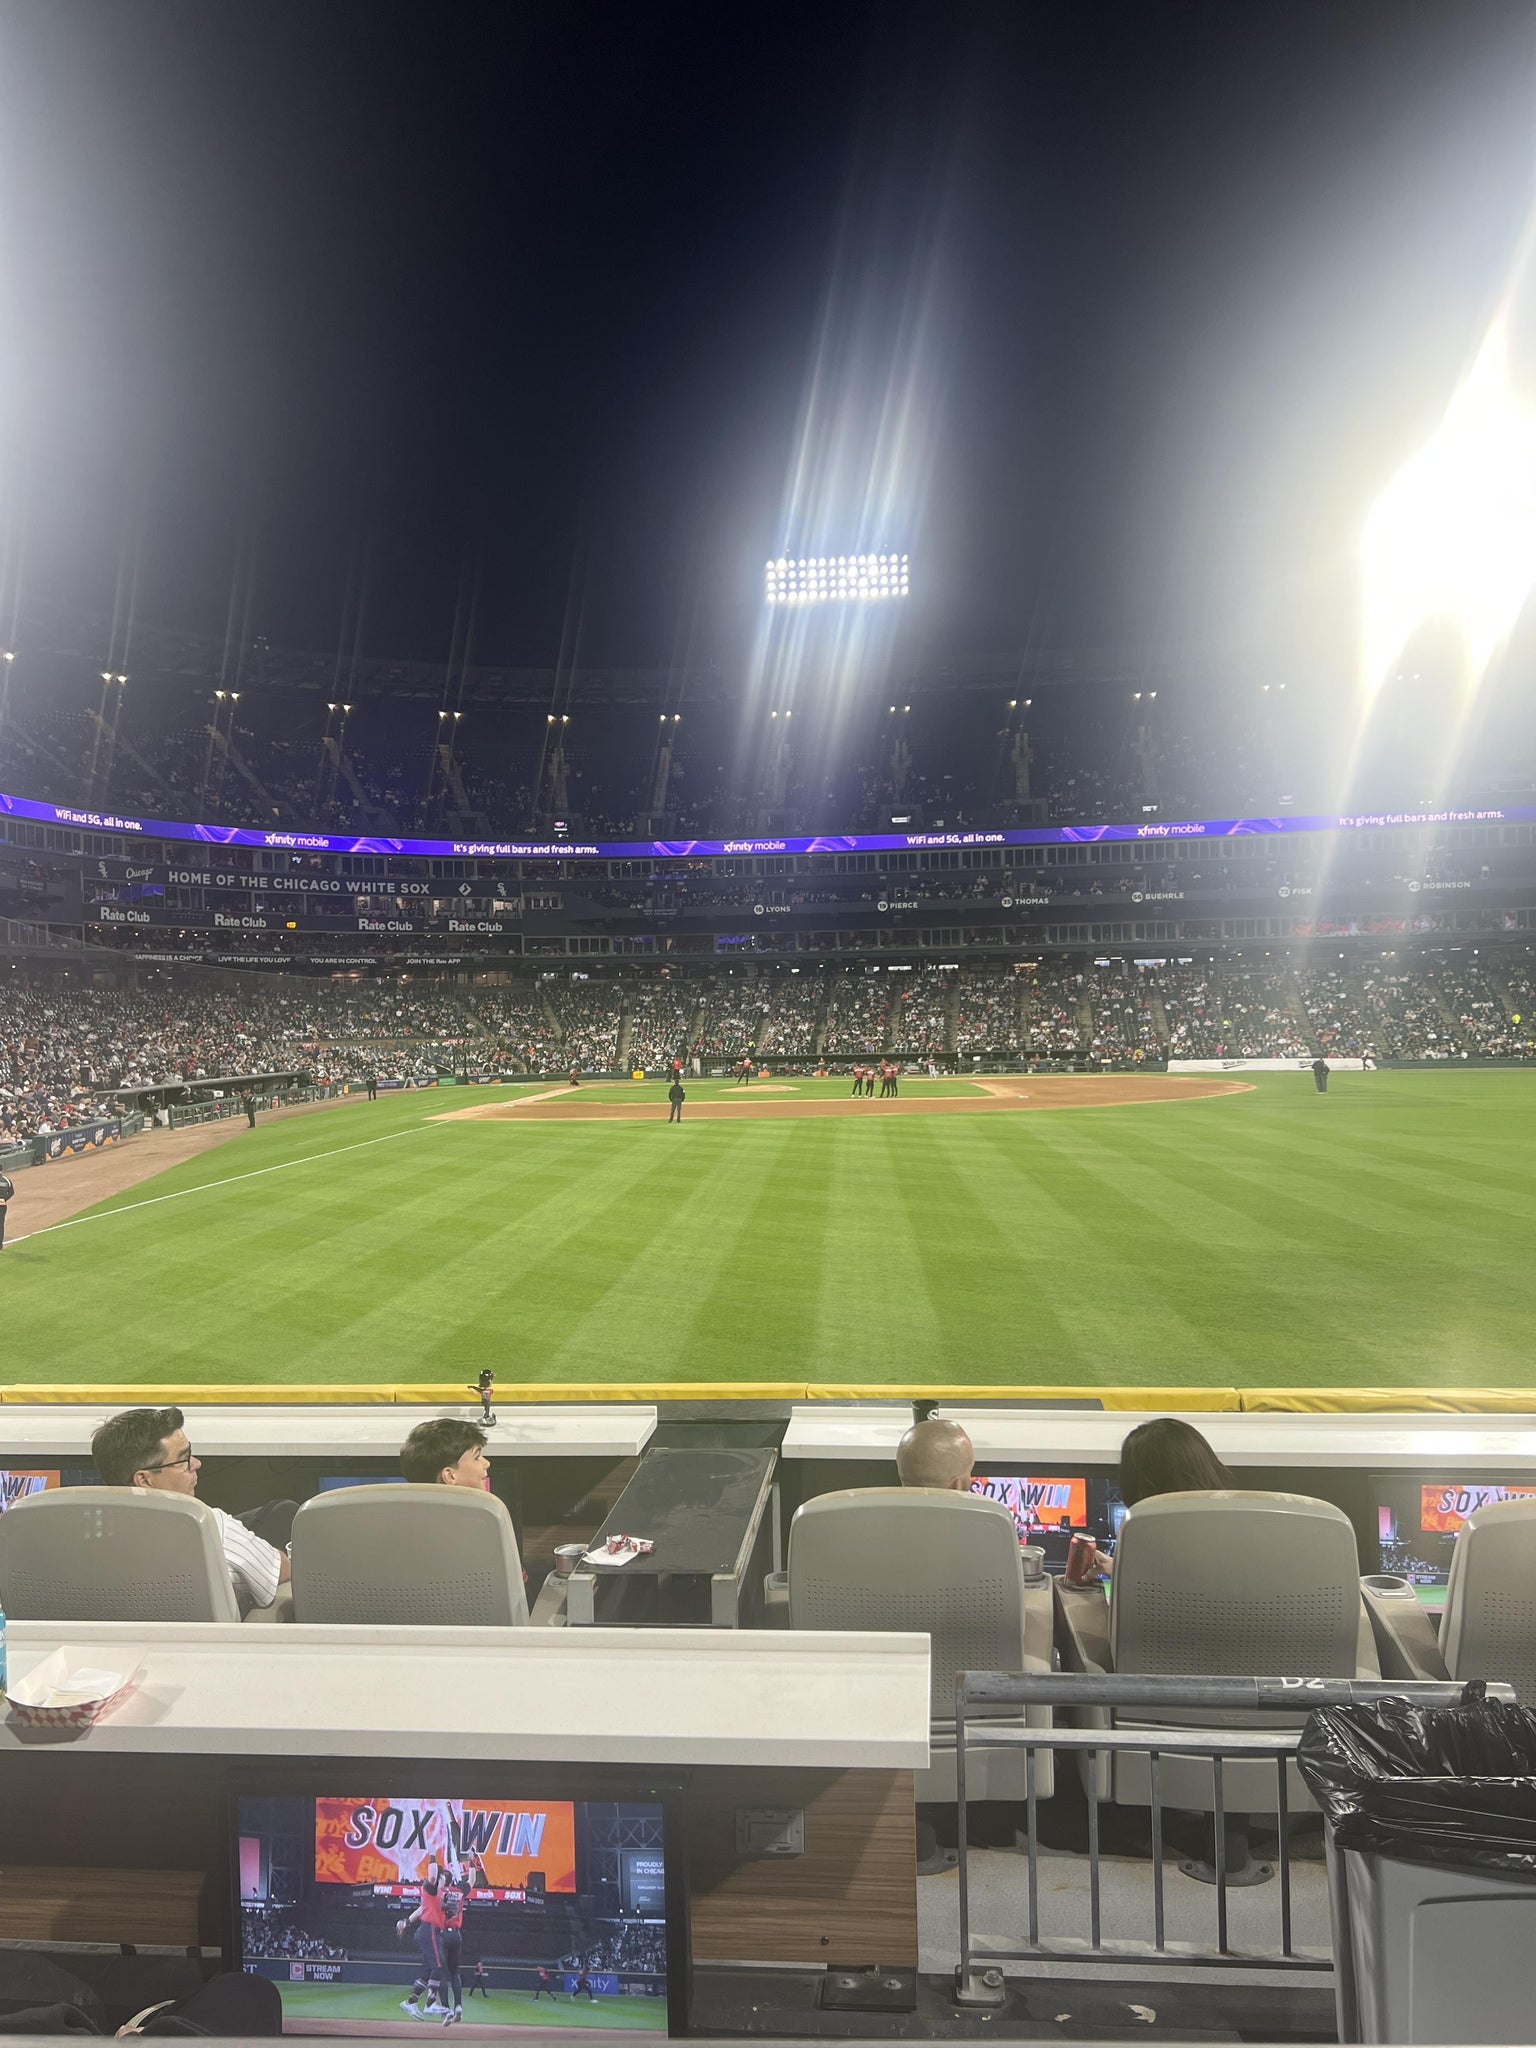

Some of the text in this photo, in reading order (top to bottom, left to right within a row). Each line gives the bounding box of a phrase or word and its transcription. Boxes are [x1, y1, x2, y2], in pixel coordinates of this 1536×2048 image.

[55, 808, 142, 830] WiFi and 5G, all in one.
[1339, 810, 1504, 826] It's giving full bars and fresh arms.
[1137, 824, 1206, 837] xfinity mobile
[265, 832, 330, 848] xfinity mobile
[723, 840, 786, 852] xfinity mobile
[907, 834, 1006, 844] WiFi and 5G, all in one.
[453, 844, 600, 854] It's giving full bars and fresh arms.
[168, 871, 430, 895] HOME OF THE CHICAGO WHITE SOX
[1422, 881, 1471, 889] ROBINSON
[1145, 892, 1184, 900] BUEHRLE
[100, 906, 150, 922] Rate Club
[214, 914, 266, 928] Rate Club
[358, 918, 413, 931] Rate Club
[448, 920, 502, 932] Rate Club
[1026, 1482, 1071, 1508] WIN
[1437, 1488, 1488, 1514] SOX
[345, 1805, 435, 1850] SOX
[460, 1809, 547, 1857] WIN
[306, 1964, 340, 1973] STREAM
[570, 1978, 610, 1992] xnity
